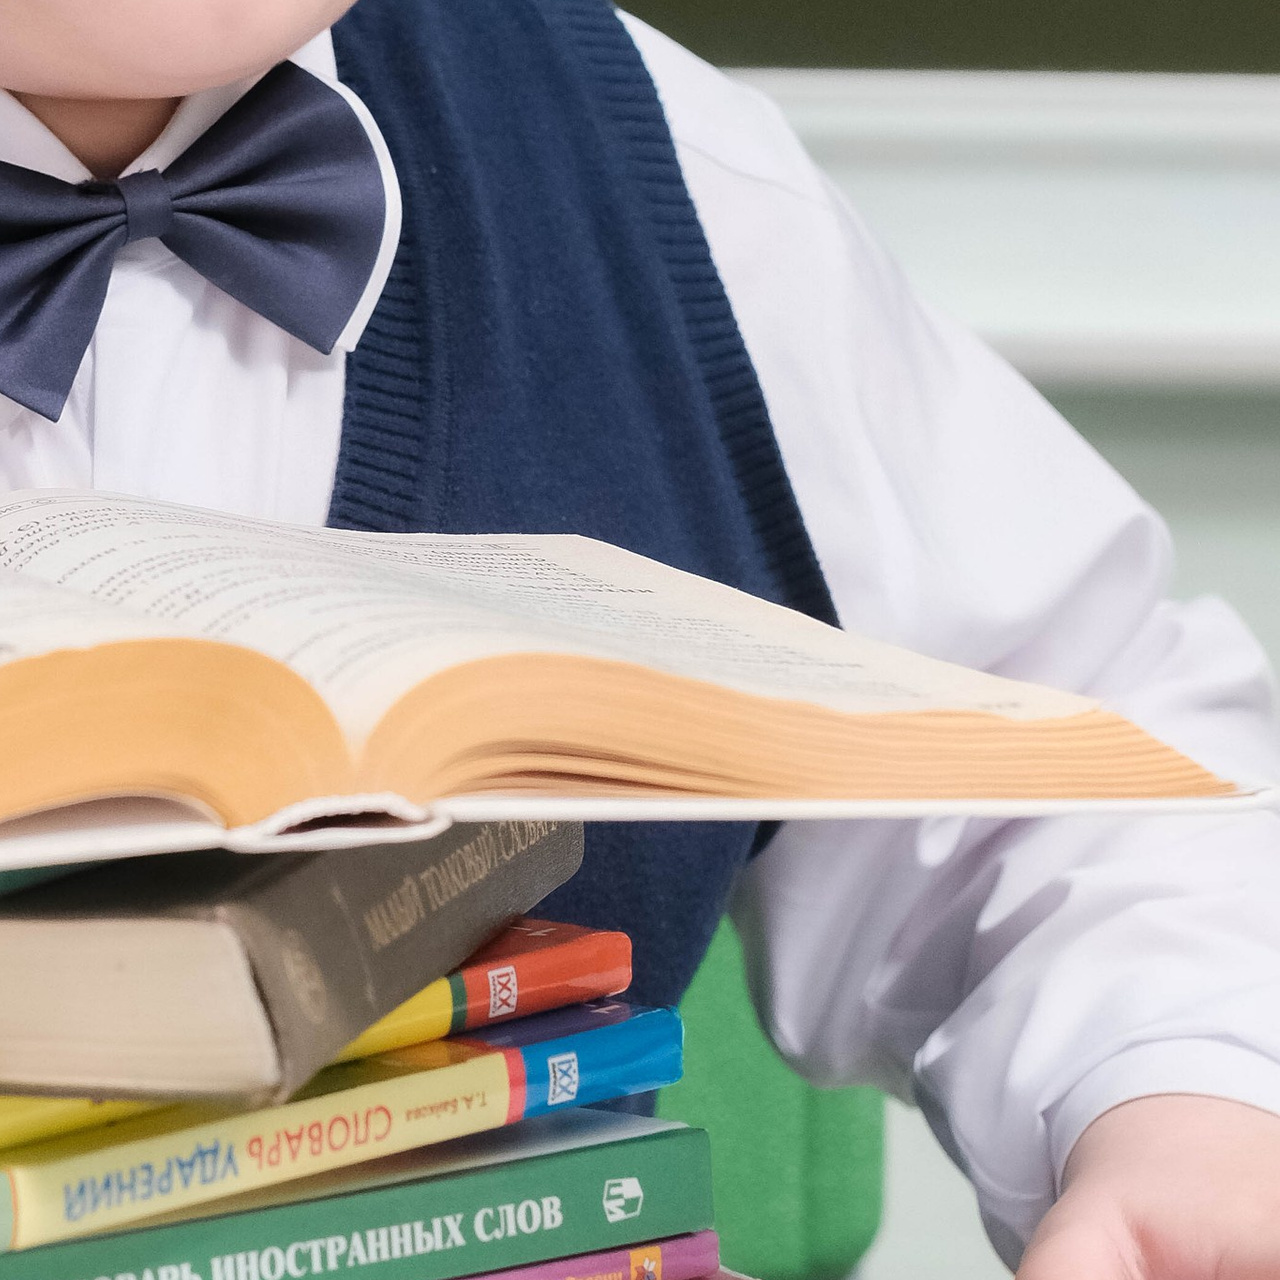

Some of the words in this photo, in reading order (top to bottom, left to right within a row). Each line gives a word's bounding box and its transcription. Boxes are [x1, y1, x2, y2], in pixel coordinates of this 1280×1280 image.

[247, 1105, 393, 1170] СЛОВАРЬ
[63, 1139, 238, 1222] УДАРЕНИЙ
[473, 1195, 564, 1243] СЛОВ
